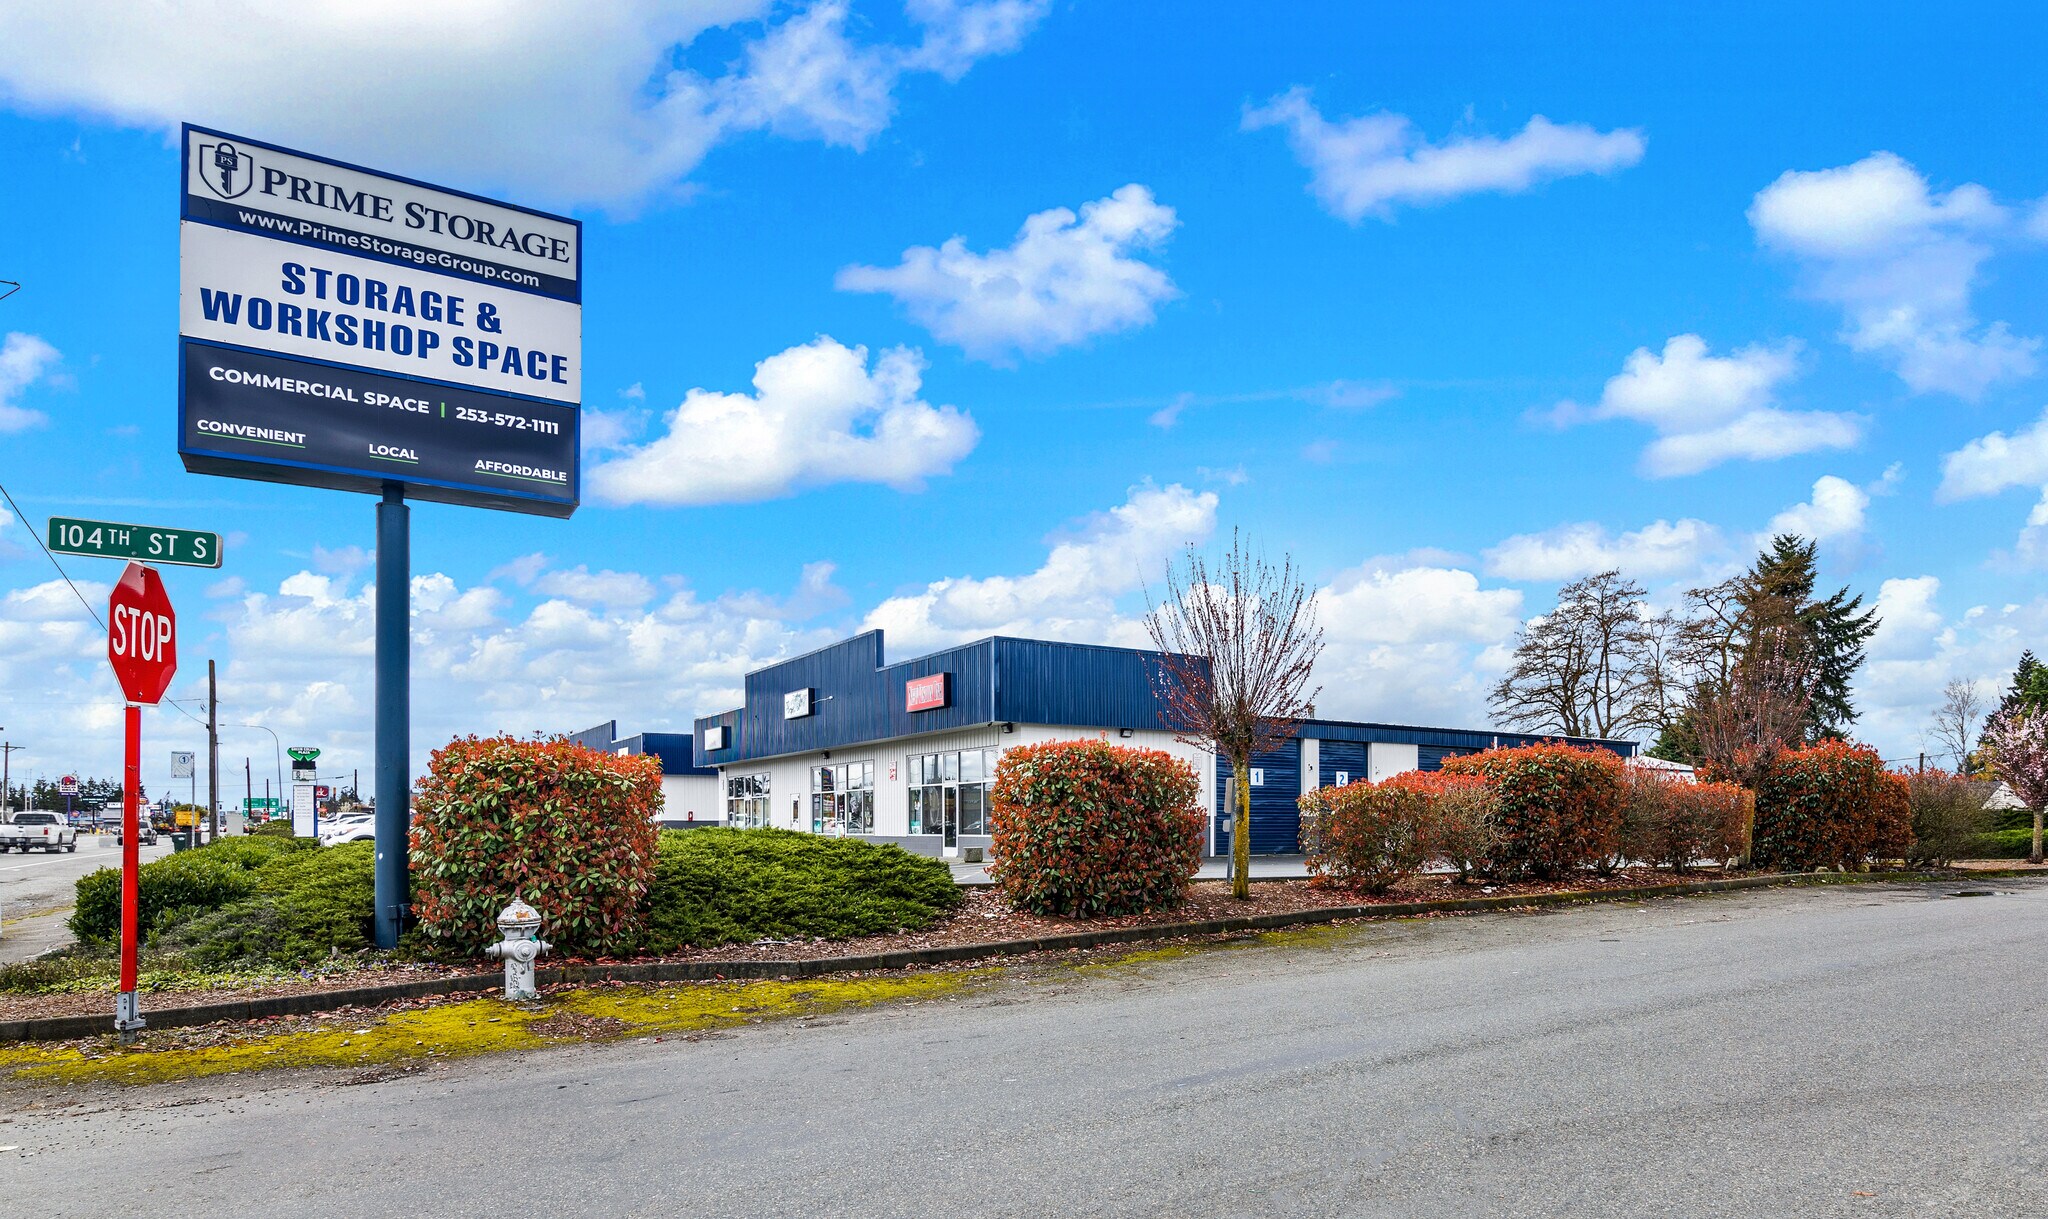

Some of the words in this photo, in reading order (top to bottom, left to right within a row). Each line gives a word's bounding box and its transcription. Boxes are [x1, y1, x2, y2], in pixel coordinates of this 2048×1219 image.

[221, 156, 233, 165] PS
[260, 166, 394, 223] PRIME
[405, 201, 570, 263] STORAGE
[238, 210, 540, 287] www.PrimeStorageGroup.com
[281, 262, 465, 327] STORAGE
[476, 302, 502, 334] &
[199, 287, 440, 360] WORKSHOP
[452, 336, 568, 385] SPACE
[209, 366, 359, 403] COMMERCIAL
[363, 391, 430, 414] SPACE
[455, 406, 559, 435] 253-572-1111
[197, 419, 307, 444] CONVENIENT
[368, 443, 419, 460] LOCAL
[474, 459, 567, 482] AFFORDABLE
[59, 524, 130, 549] 104TH
[148, 532, 178, 556] ST
[192, 537, 207, 559] S
[112, 603, 172, 662] STOP
[1254, 771, 1260, 783] 1
[1339, 774, 1345, 785] 2
